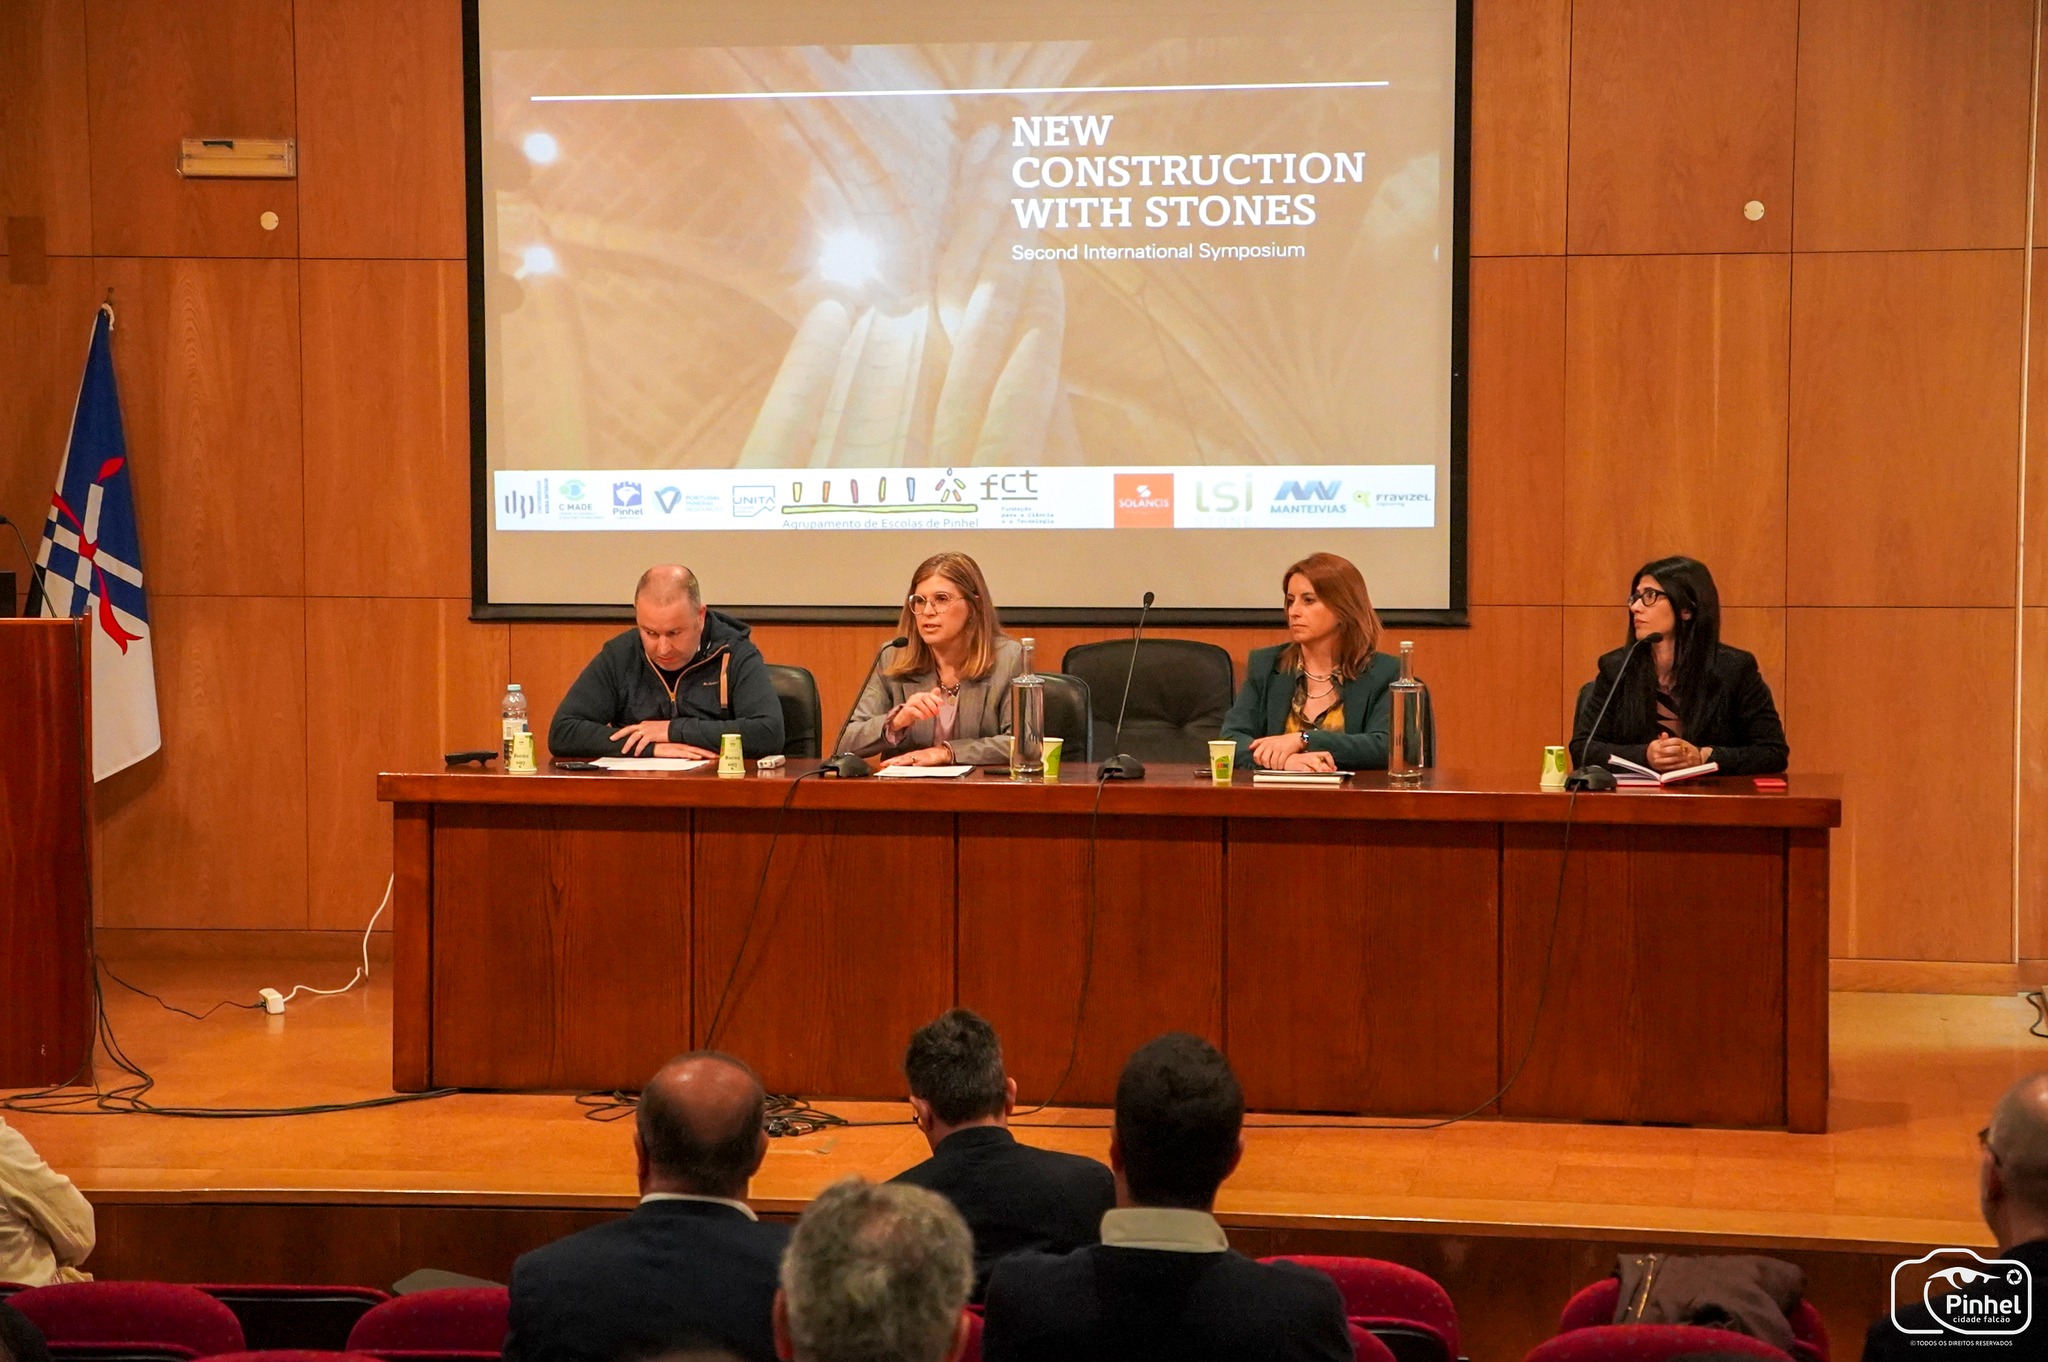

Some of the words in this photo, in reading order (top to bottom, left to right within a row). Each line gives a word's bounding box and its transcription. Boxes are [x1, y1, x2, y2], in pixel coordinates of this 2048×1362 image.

[1012, 115, 1113, 147] NEW
[1012, 152, 1365, 188] CONSTRUCTION
[1011, 197, 1132, 228] WITH
[1145, 194, 1316, 228] STONES
[1012, 244, 1078, 261] Second
[1084, 243, 1193, 260] International
[1198, 242, 1305, 261] Symposium
[980, 470, 1038, 500] fct
[732, 496, 775, 505] UNITA
[1119, 499, 1169, 508] SOLANCIS
[558, 503, 565, 511] C
[567, 503, 593, 511] MADE
[612, 507, 643, 516] Pinhel
[1270, 504, 1347, 514] MANTEIVIAS
[782, 519, 861, 529] Agrupamento
[864, 518, 878, 528] de
[881, 518, 923, 528] Escolas
[926, 518, 939, 528] de
[943, 518, 979, 528] Pinhel
